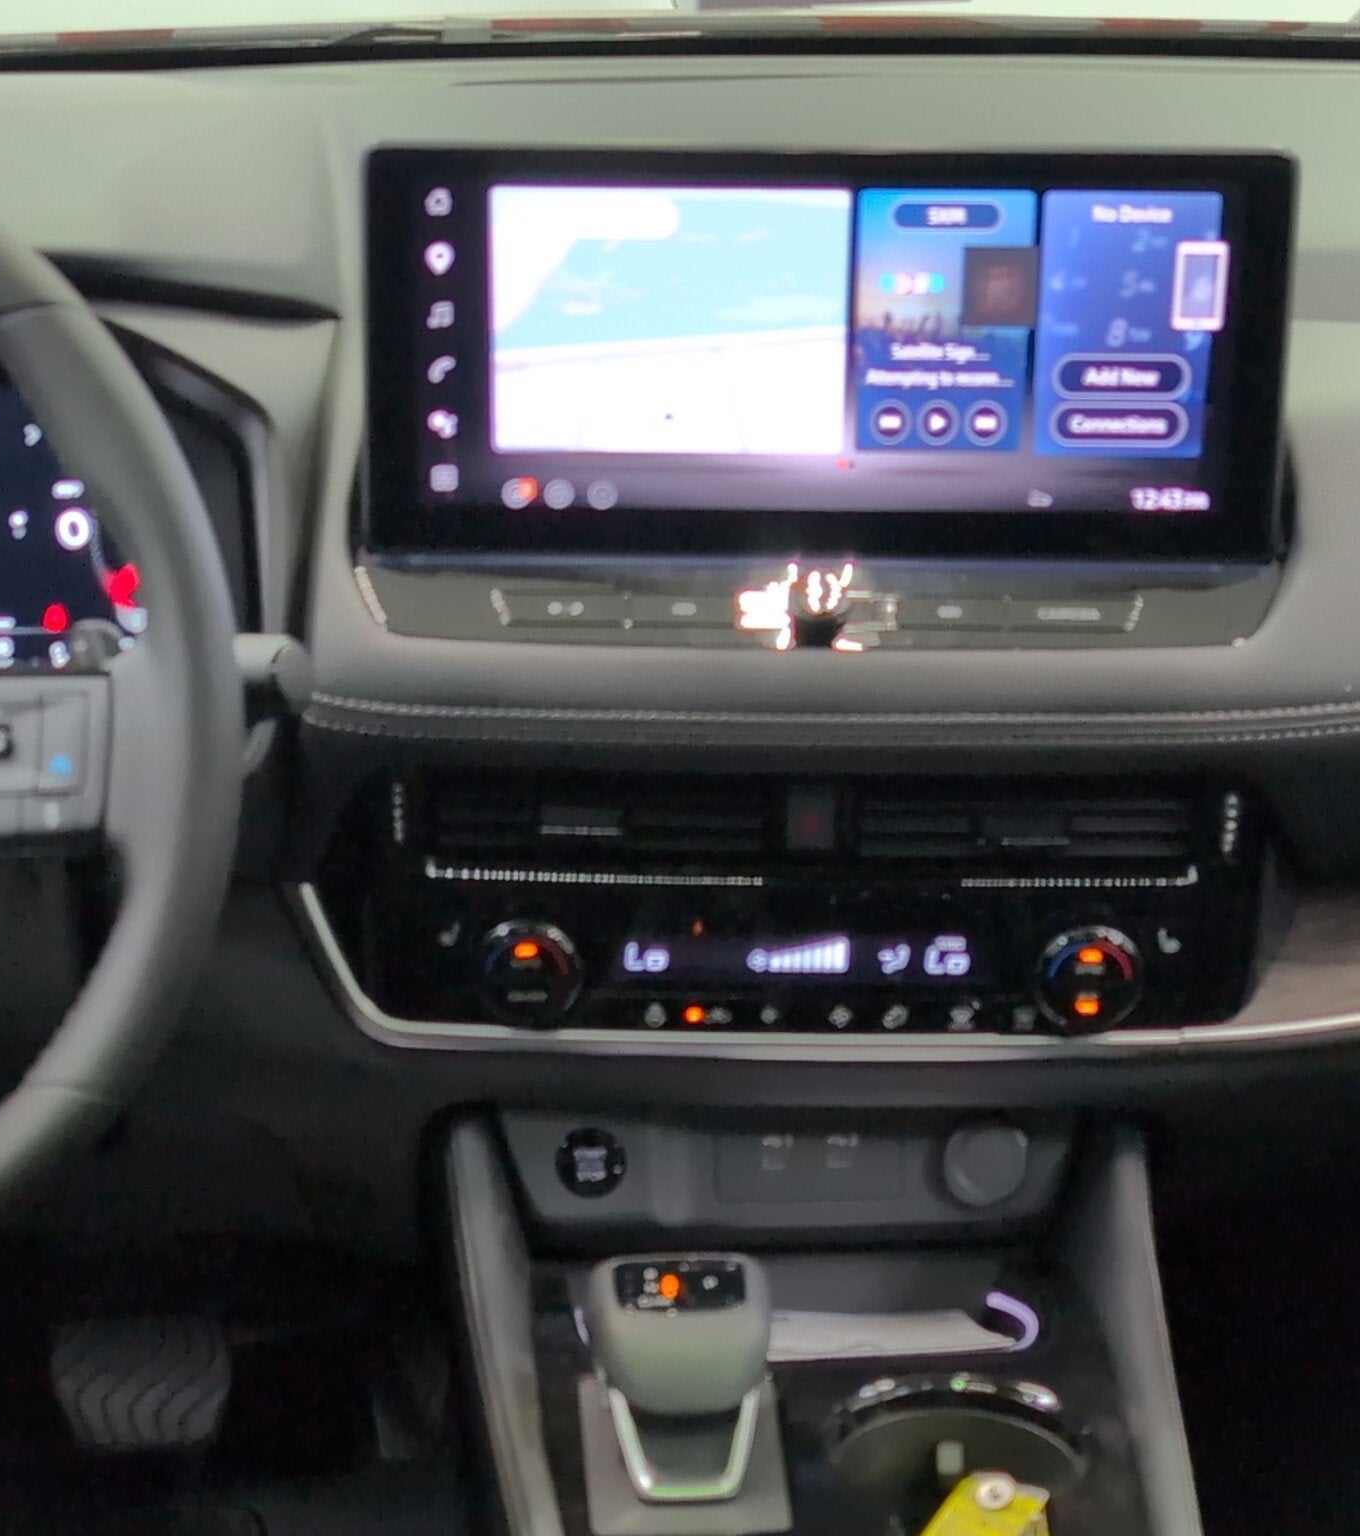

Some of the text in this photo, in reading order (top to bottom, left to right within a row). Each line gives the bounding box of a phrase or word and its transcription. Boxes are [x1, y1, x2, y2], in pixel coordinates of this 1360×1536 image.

[1091, 204, 1173, 223] No Device
[1081, 366, 1118, 387] Add
[1066, 412, 1169, 436] Connections
